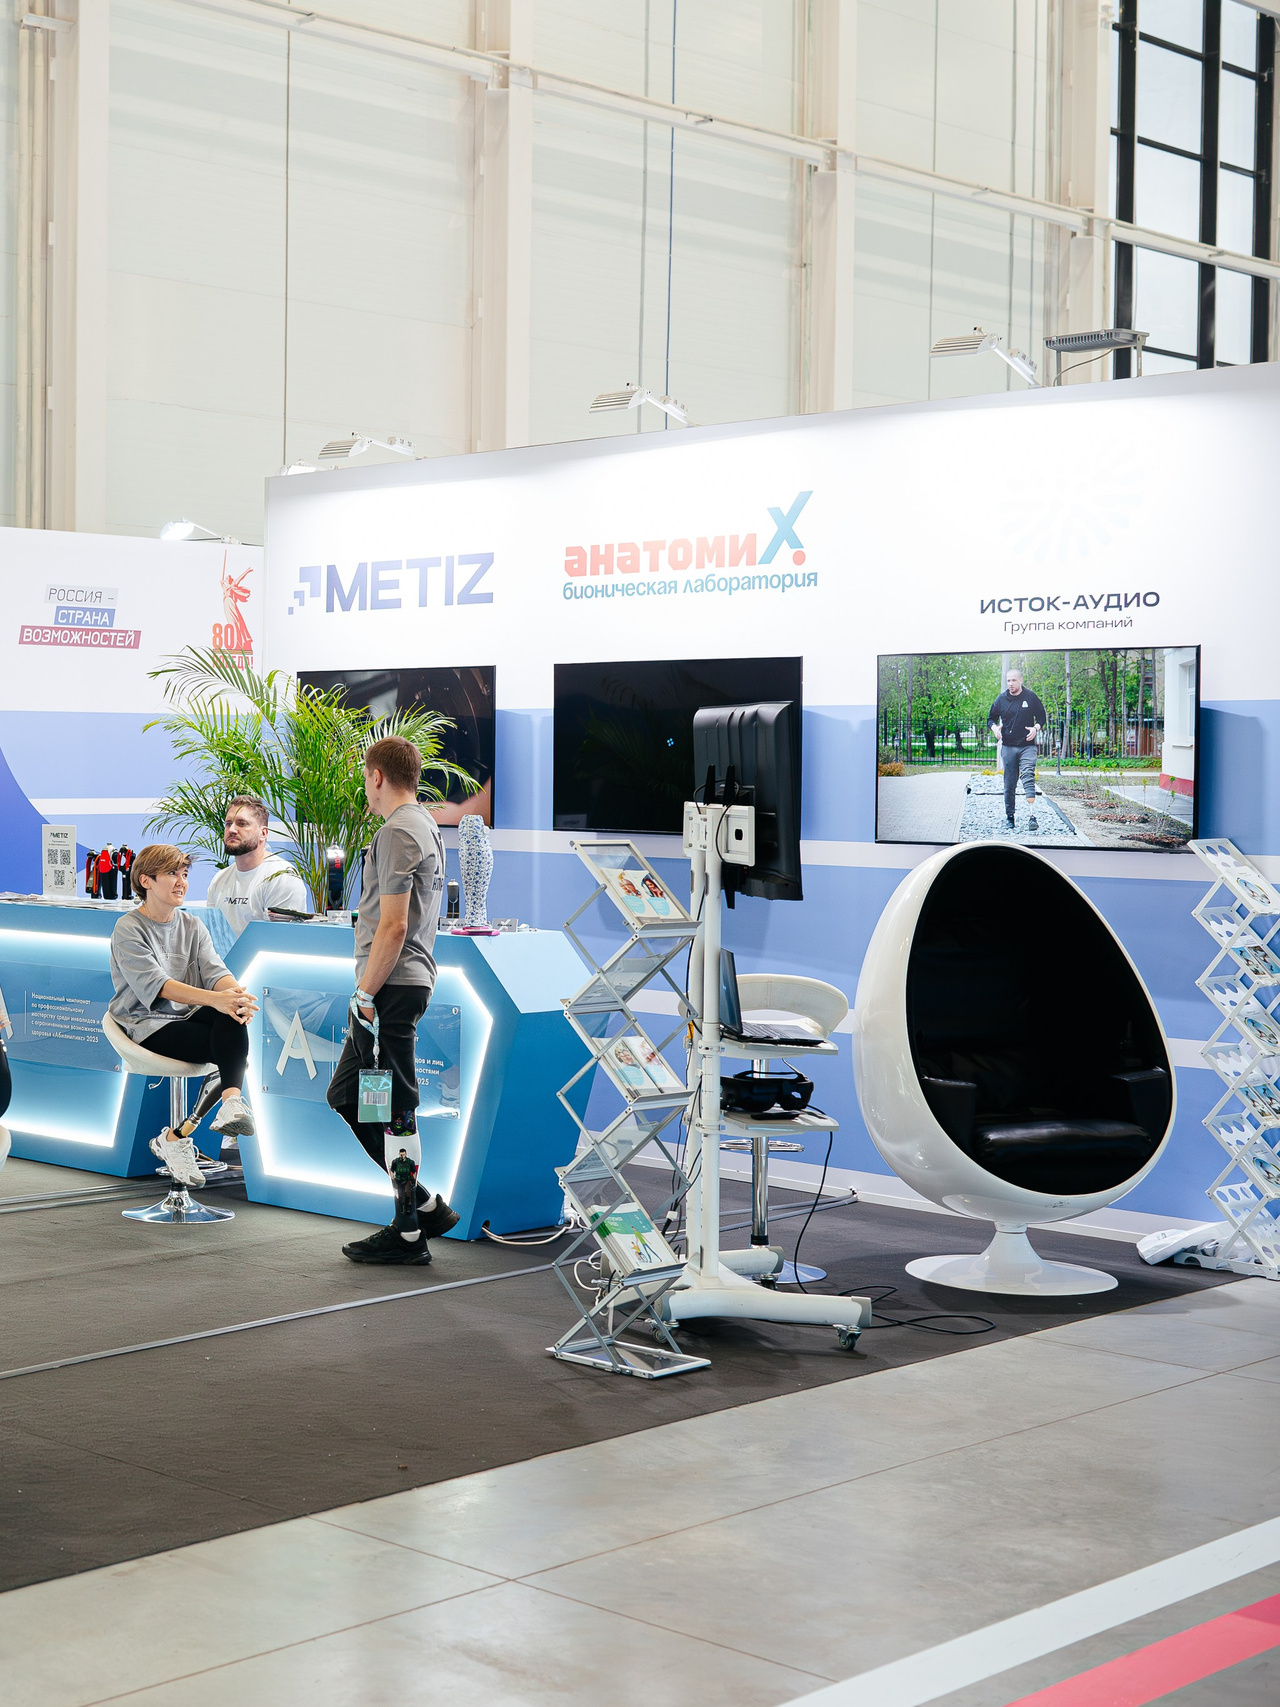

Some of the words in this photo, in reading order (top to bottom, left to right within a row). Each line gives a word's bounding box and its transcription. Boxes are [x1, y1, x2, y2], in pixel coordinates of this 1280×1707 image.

[326, 552, 495, 613] METIZ
[563, 579, 678, 600] бионическая
[683, 571, 818, 596] лаборатория
[48, 587, 103, 603] РОССИЯ
[980, 591, 1161, 614] ИСТОК-АУДИО
[57, 609, 110, 626] СТРАНА
[1004, 620, 1055, 635] Группа
[1058, 616, 1133, 631] компаний
[22, 628, 136, 647] ВОЗМОЖНОСТЕЙ
[212, 622, 235, 650] 80
[228, 897, 249, 905] METIZ
[415, 1067, 440, 1075] ностями
[417, 1077, 429, 1086] 025
